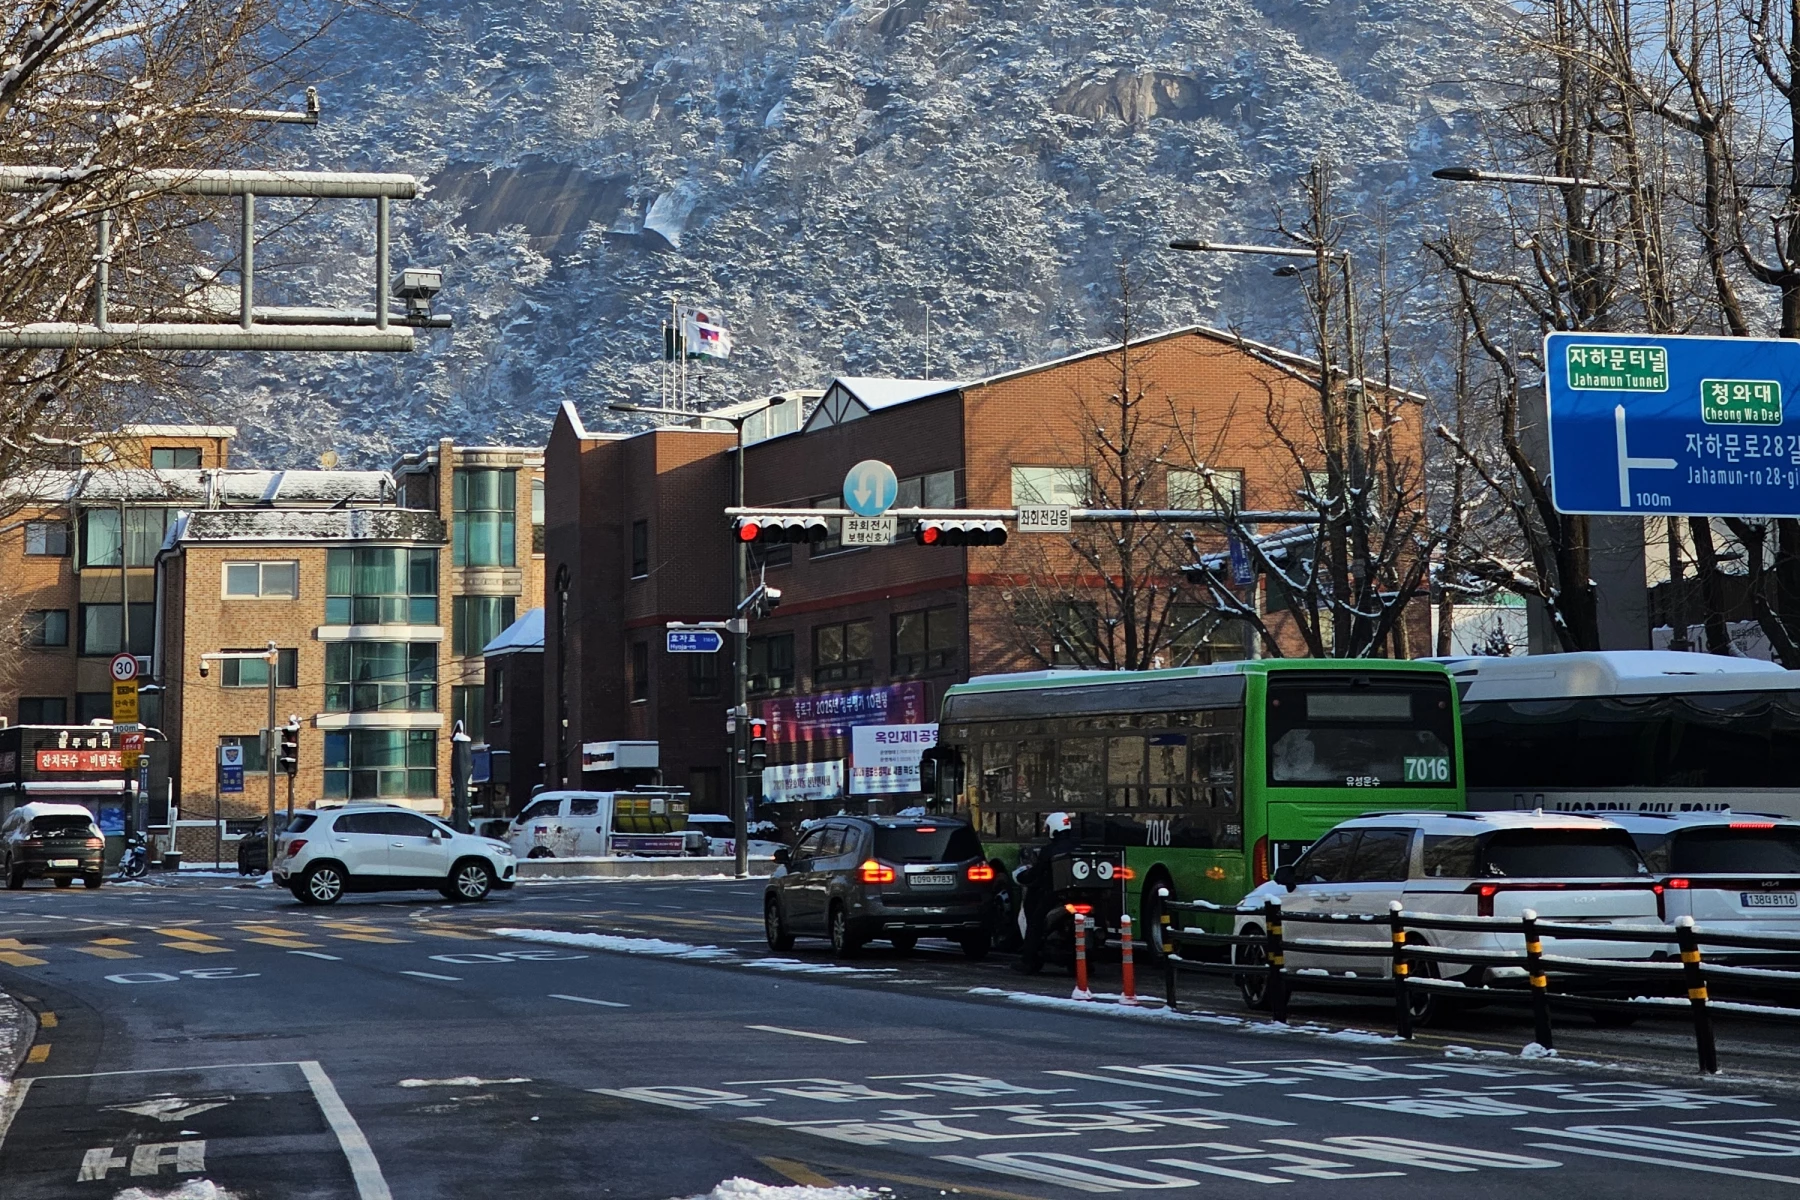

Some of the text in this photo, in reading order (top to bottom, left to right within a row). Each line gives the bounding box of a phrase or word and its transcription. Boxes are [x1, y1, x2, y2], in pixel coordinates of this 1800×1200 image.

[1570, 348, 1665, 373] 자하문터널
[1573, 372, 1664, 388] Jahamun Tunnel
[1711, 383, 1772, 405] 청와대
[1705, 407, 1780, 423] Cheong Wa Dae
[1687, 466, 1762, 485] Jahamun-ro
[1636, 492, 1672, 507] 100m
[1021, 509, 1069, 526] 좌회전감응
[848, 520, 892, 531] 좌회전시
[848, 531, 891, 543] 보행신호시
[670, 634, 697, 643] 효자로
[670, 643, 697, 651] Hyoja-ro
[115, 661, 133, 675] 30
[115, 725, 136, 733] 100m
[41, 753, 79, 767] 잔치국수
[1406, 757, 1448, 781] 7016
[1345, 776, 1381, 787] 유성운수
[1145, 819, 1171, 846] 7016
[1773, 894, 1795, 905] 8116
